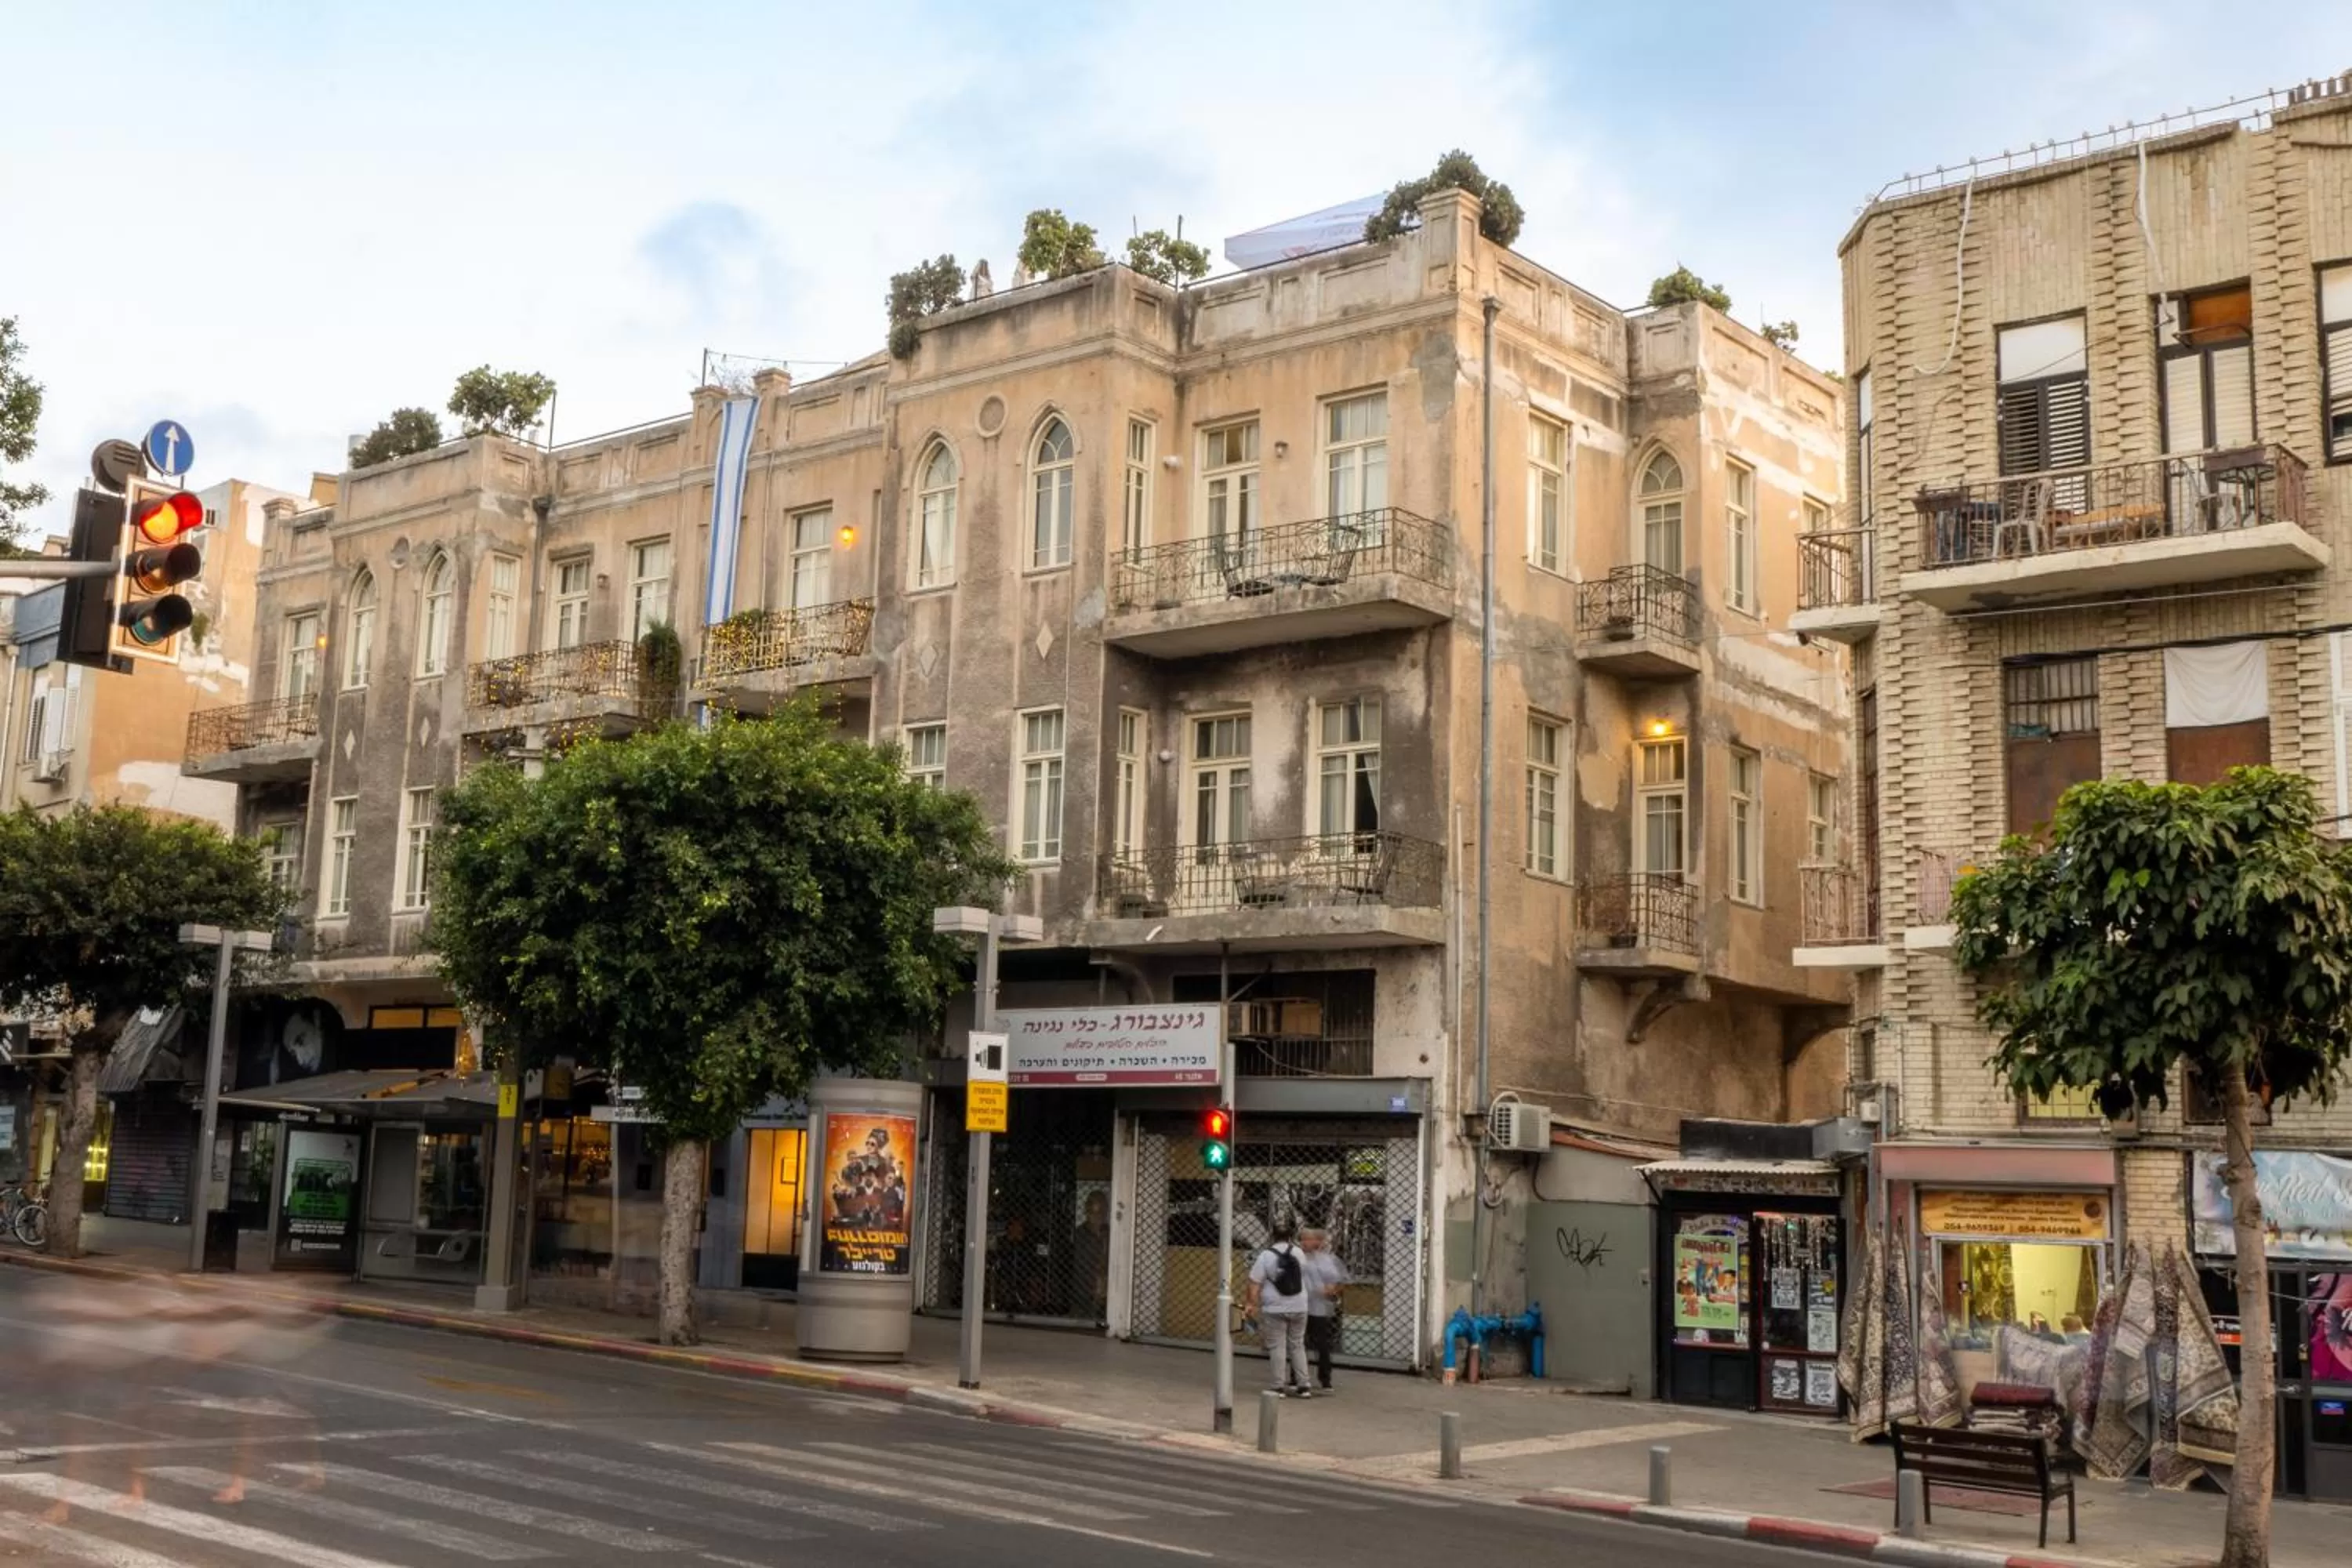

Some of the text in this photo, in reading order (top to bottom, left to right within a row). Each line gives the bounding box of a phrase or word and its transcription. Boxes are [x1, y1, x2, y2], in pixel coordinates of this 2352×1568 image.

[1022, 1020, 1065, 1033] נגינה
[1071, 1017, 1098, 1033] כלי
[1109, 1011, 1206, 1031] גינצבורג
[1018, 1056, 1207, 1068] מכירה השכרה תיקונים והערכה
